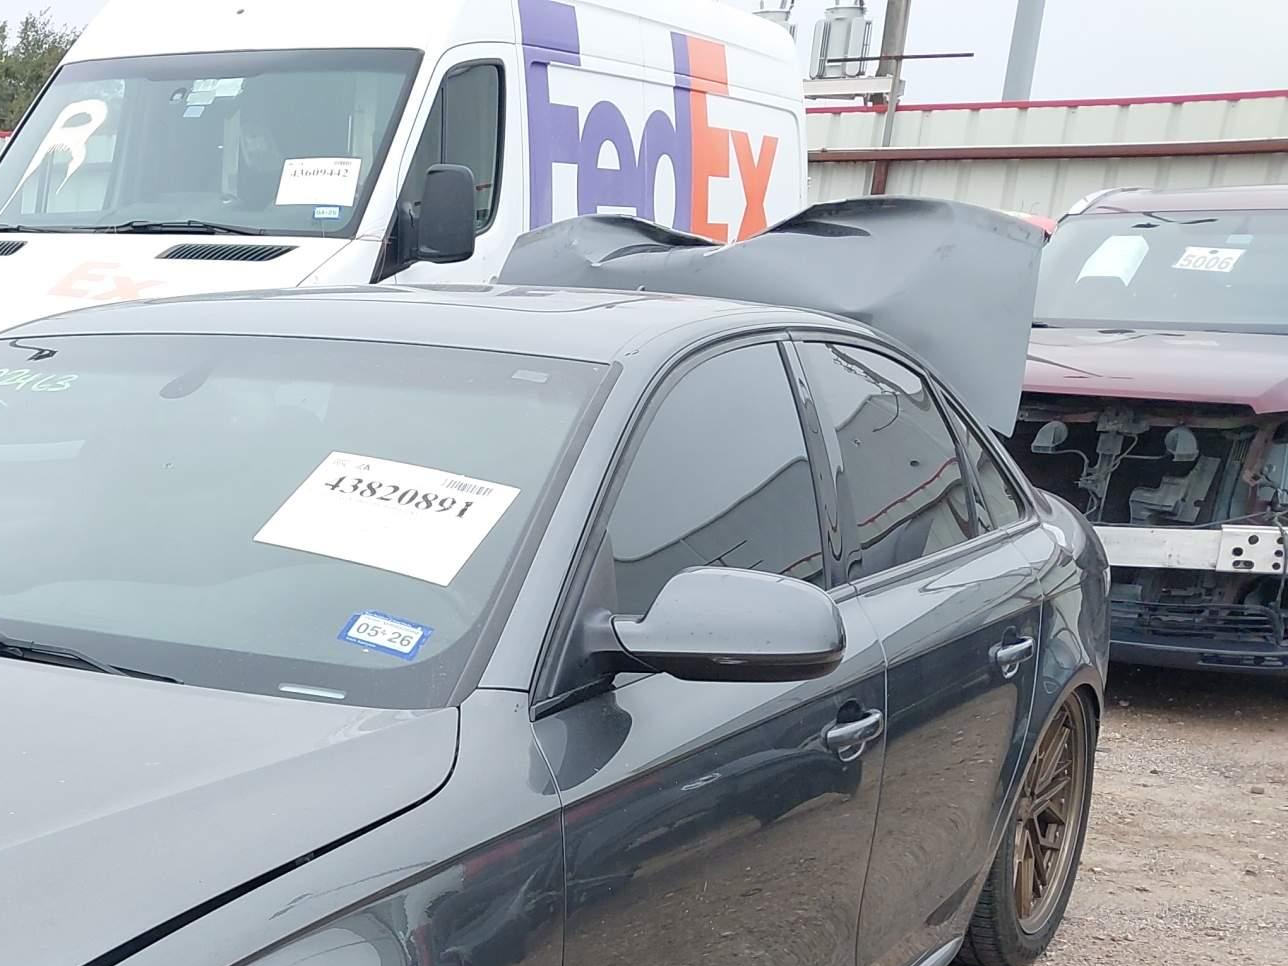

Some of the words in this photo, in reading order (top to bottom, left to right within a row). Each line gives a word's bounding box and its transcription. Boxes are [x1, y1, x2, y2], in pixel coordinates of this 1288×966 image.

[518, 0, 779, 243] FedEx
[47, 261, 169, 300] Ex
[1180, 254, 1233, 270] 5006
[325, 475, 475, 519] 43820891
